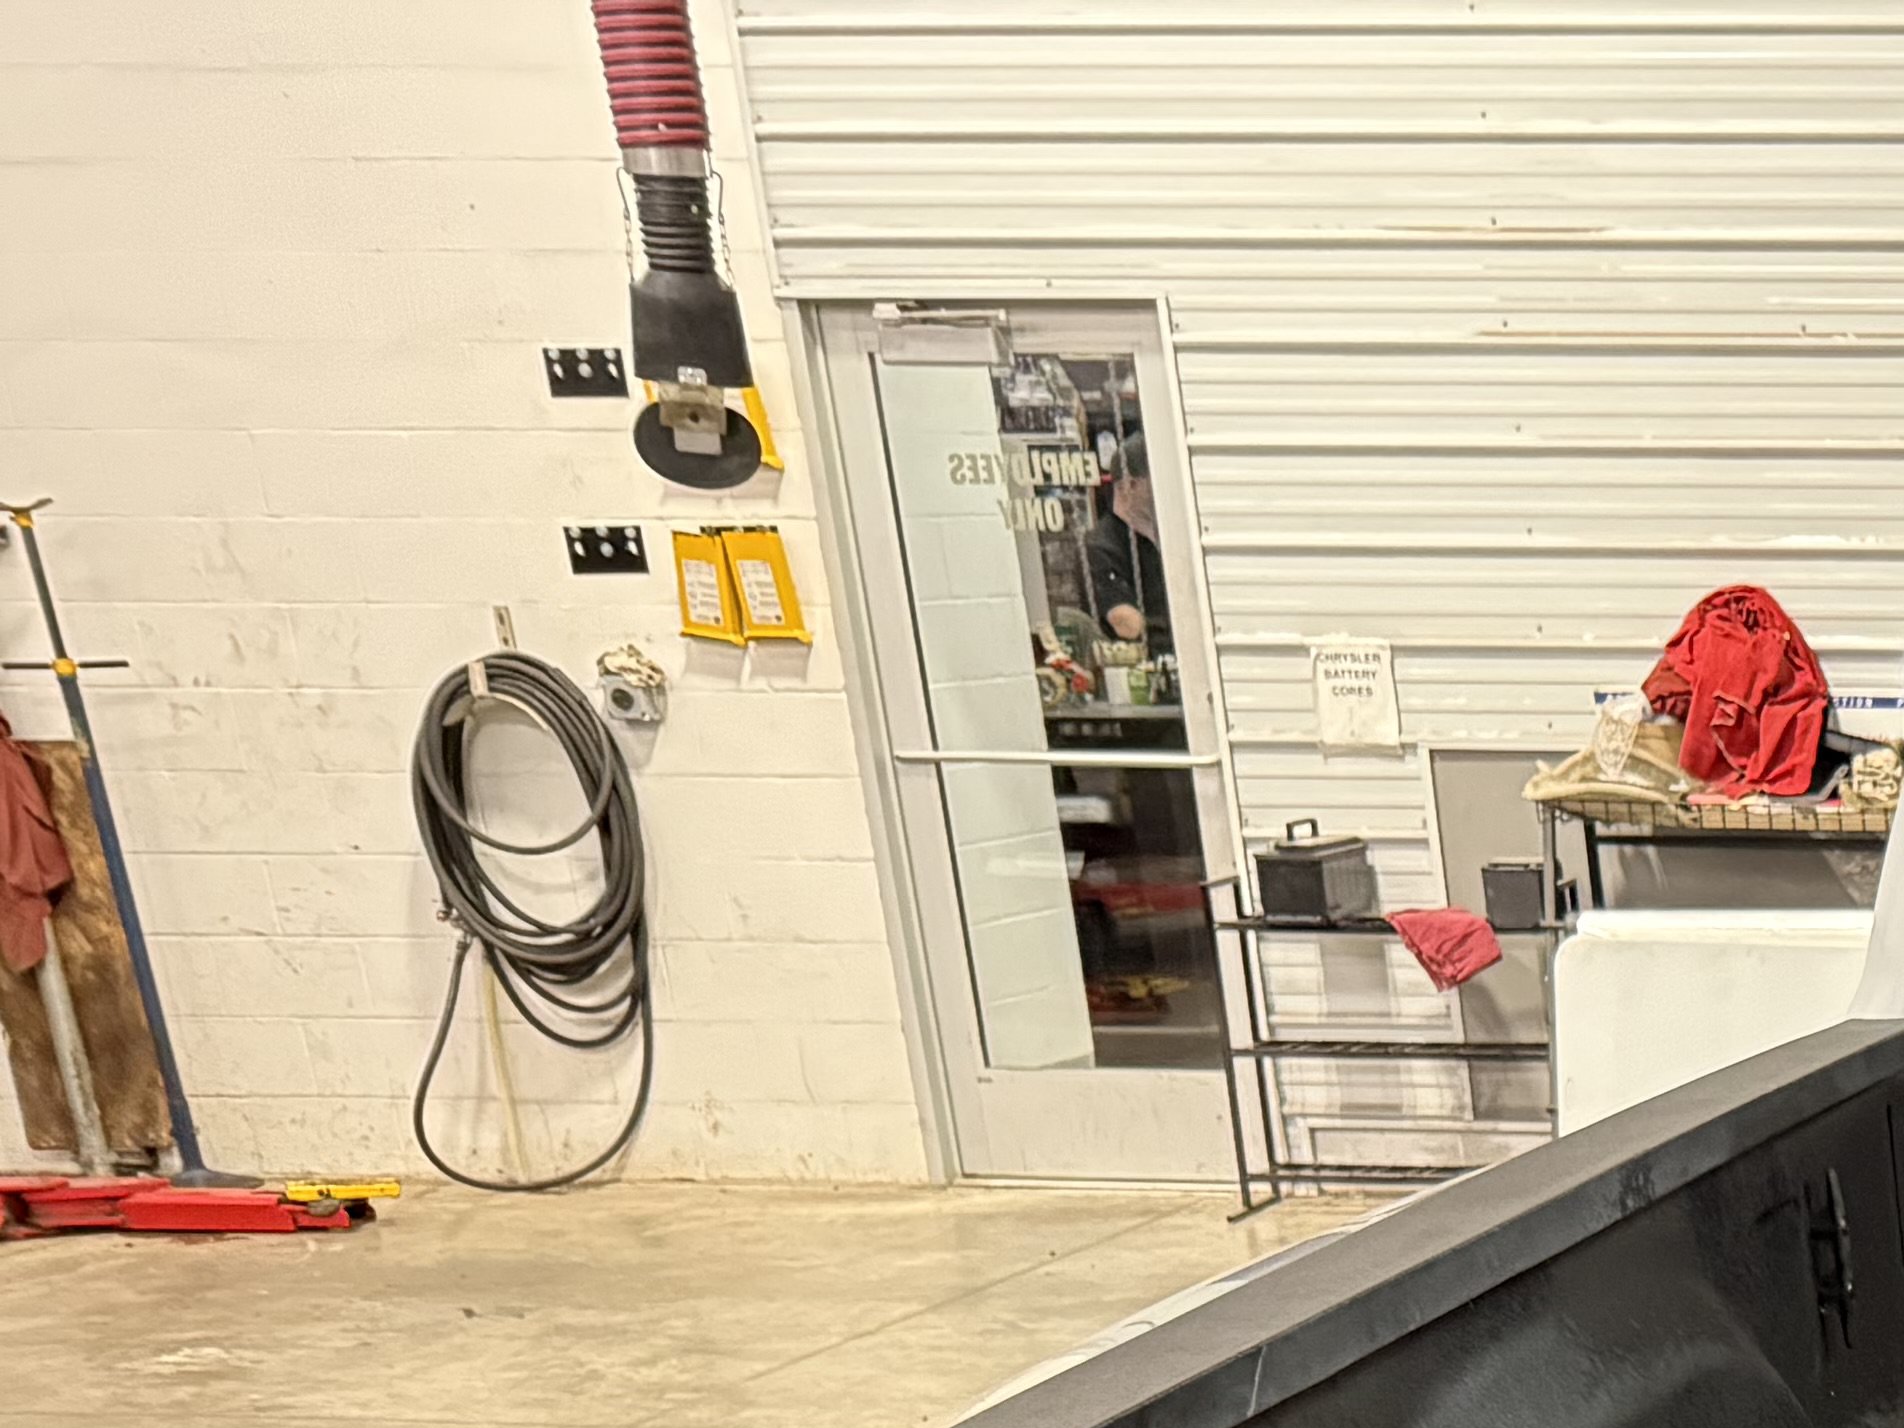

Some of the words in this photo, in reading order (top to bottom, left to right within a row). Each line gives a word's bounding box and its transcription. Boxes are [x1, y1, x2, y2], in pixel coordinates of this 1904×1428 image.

[1317, 652, 1382, 665] CHRYSLER
[1324, 669, 1377, 680] BATTERY
[1331, 686, 1373, 697] CORES
